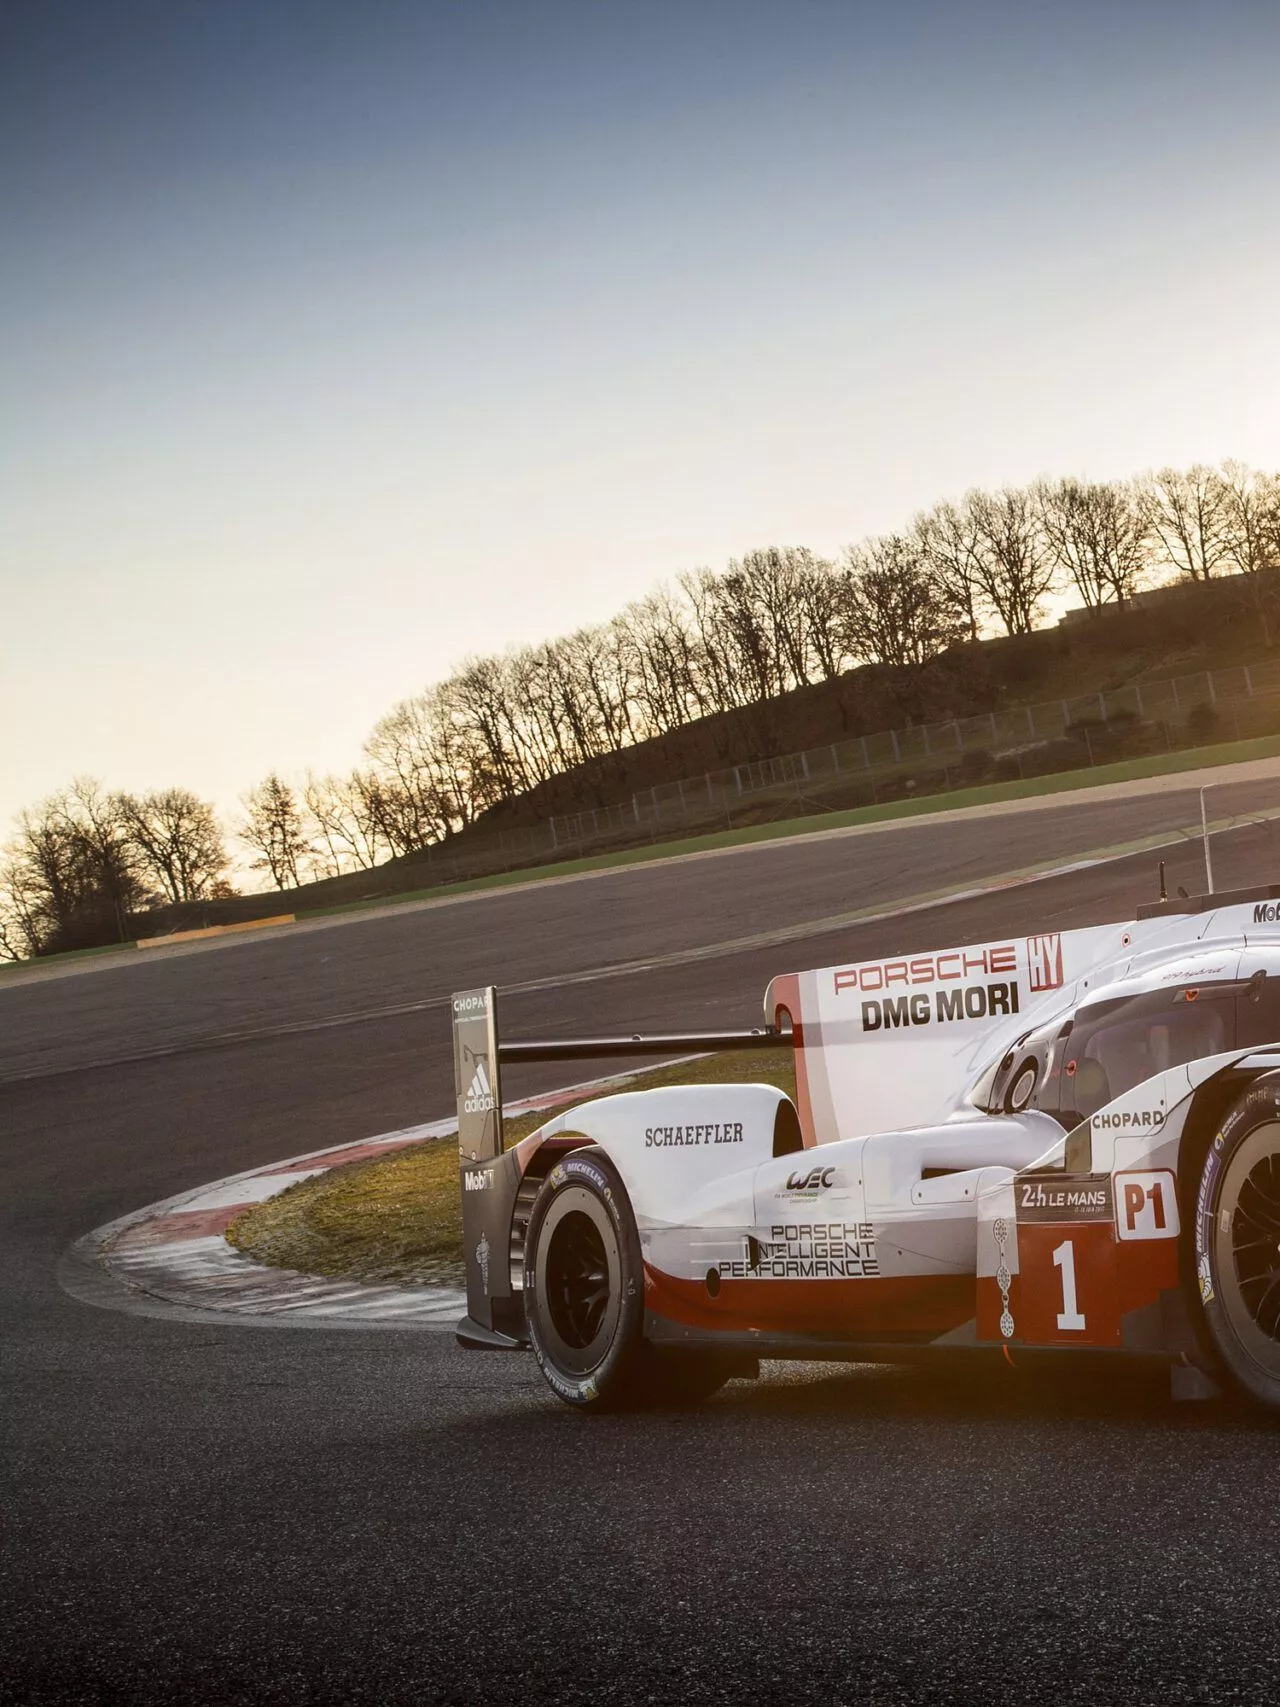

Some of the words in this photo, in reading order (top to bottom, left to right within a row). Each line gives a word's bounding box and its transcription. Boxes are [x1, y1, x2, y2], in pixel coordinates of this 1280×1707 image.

[833, 946, 1017, 995] PORSCHE
[1027, 934, 1065, 992] HY
[453, 995, 489, 1012] CHOPAR
[861, 994, 931, 1032] DMG
[936, 981, 1019, 1023] MORI
[464, 1095, 494, 1113] adidas
[1092, 1110, 1164, 1129] CHOPARD
[645, 1122, 743, 1147] SCHAEFFLER
[567, 1162, 604, 1187] MICHELIN
[786, 1167, 835, 1190] WEC
[1049, 1193, 1065, 1206] LE
[1067, 1191, 1106, 1206] MANS
[1123, 1182, 1167, 1231] P1
[1196, 1153, 1214, 1252] MICHELIN
[771, 1223, 873, 1241] PORSCHE
[745, 1241, 875, 1260] INTELLIGENT
[719, 1260, 880, 1278] PERFORMANCE
[1052, 1240, 1086, 1330] 1
